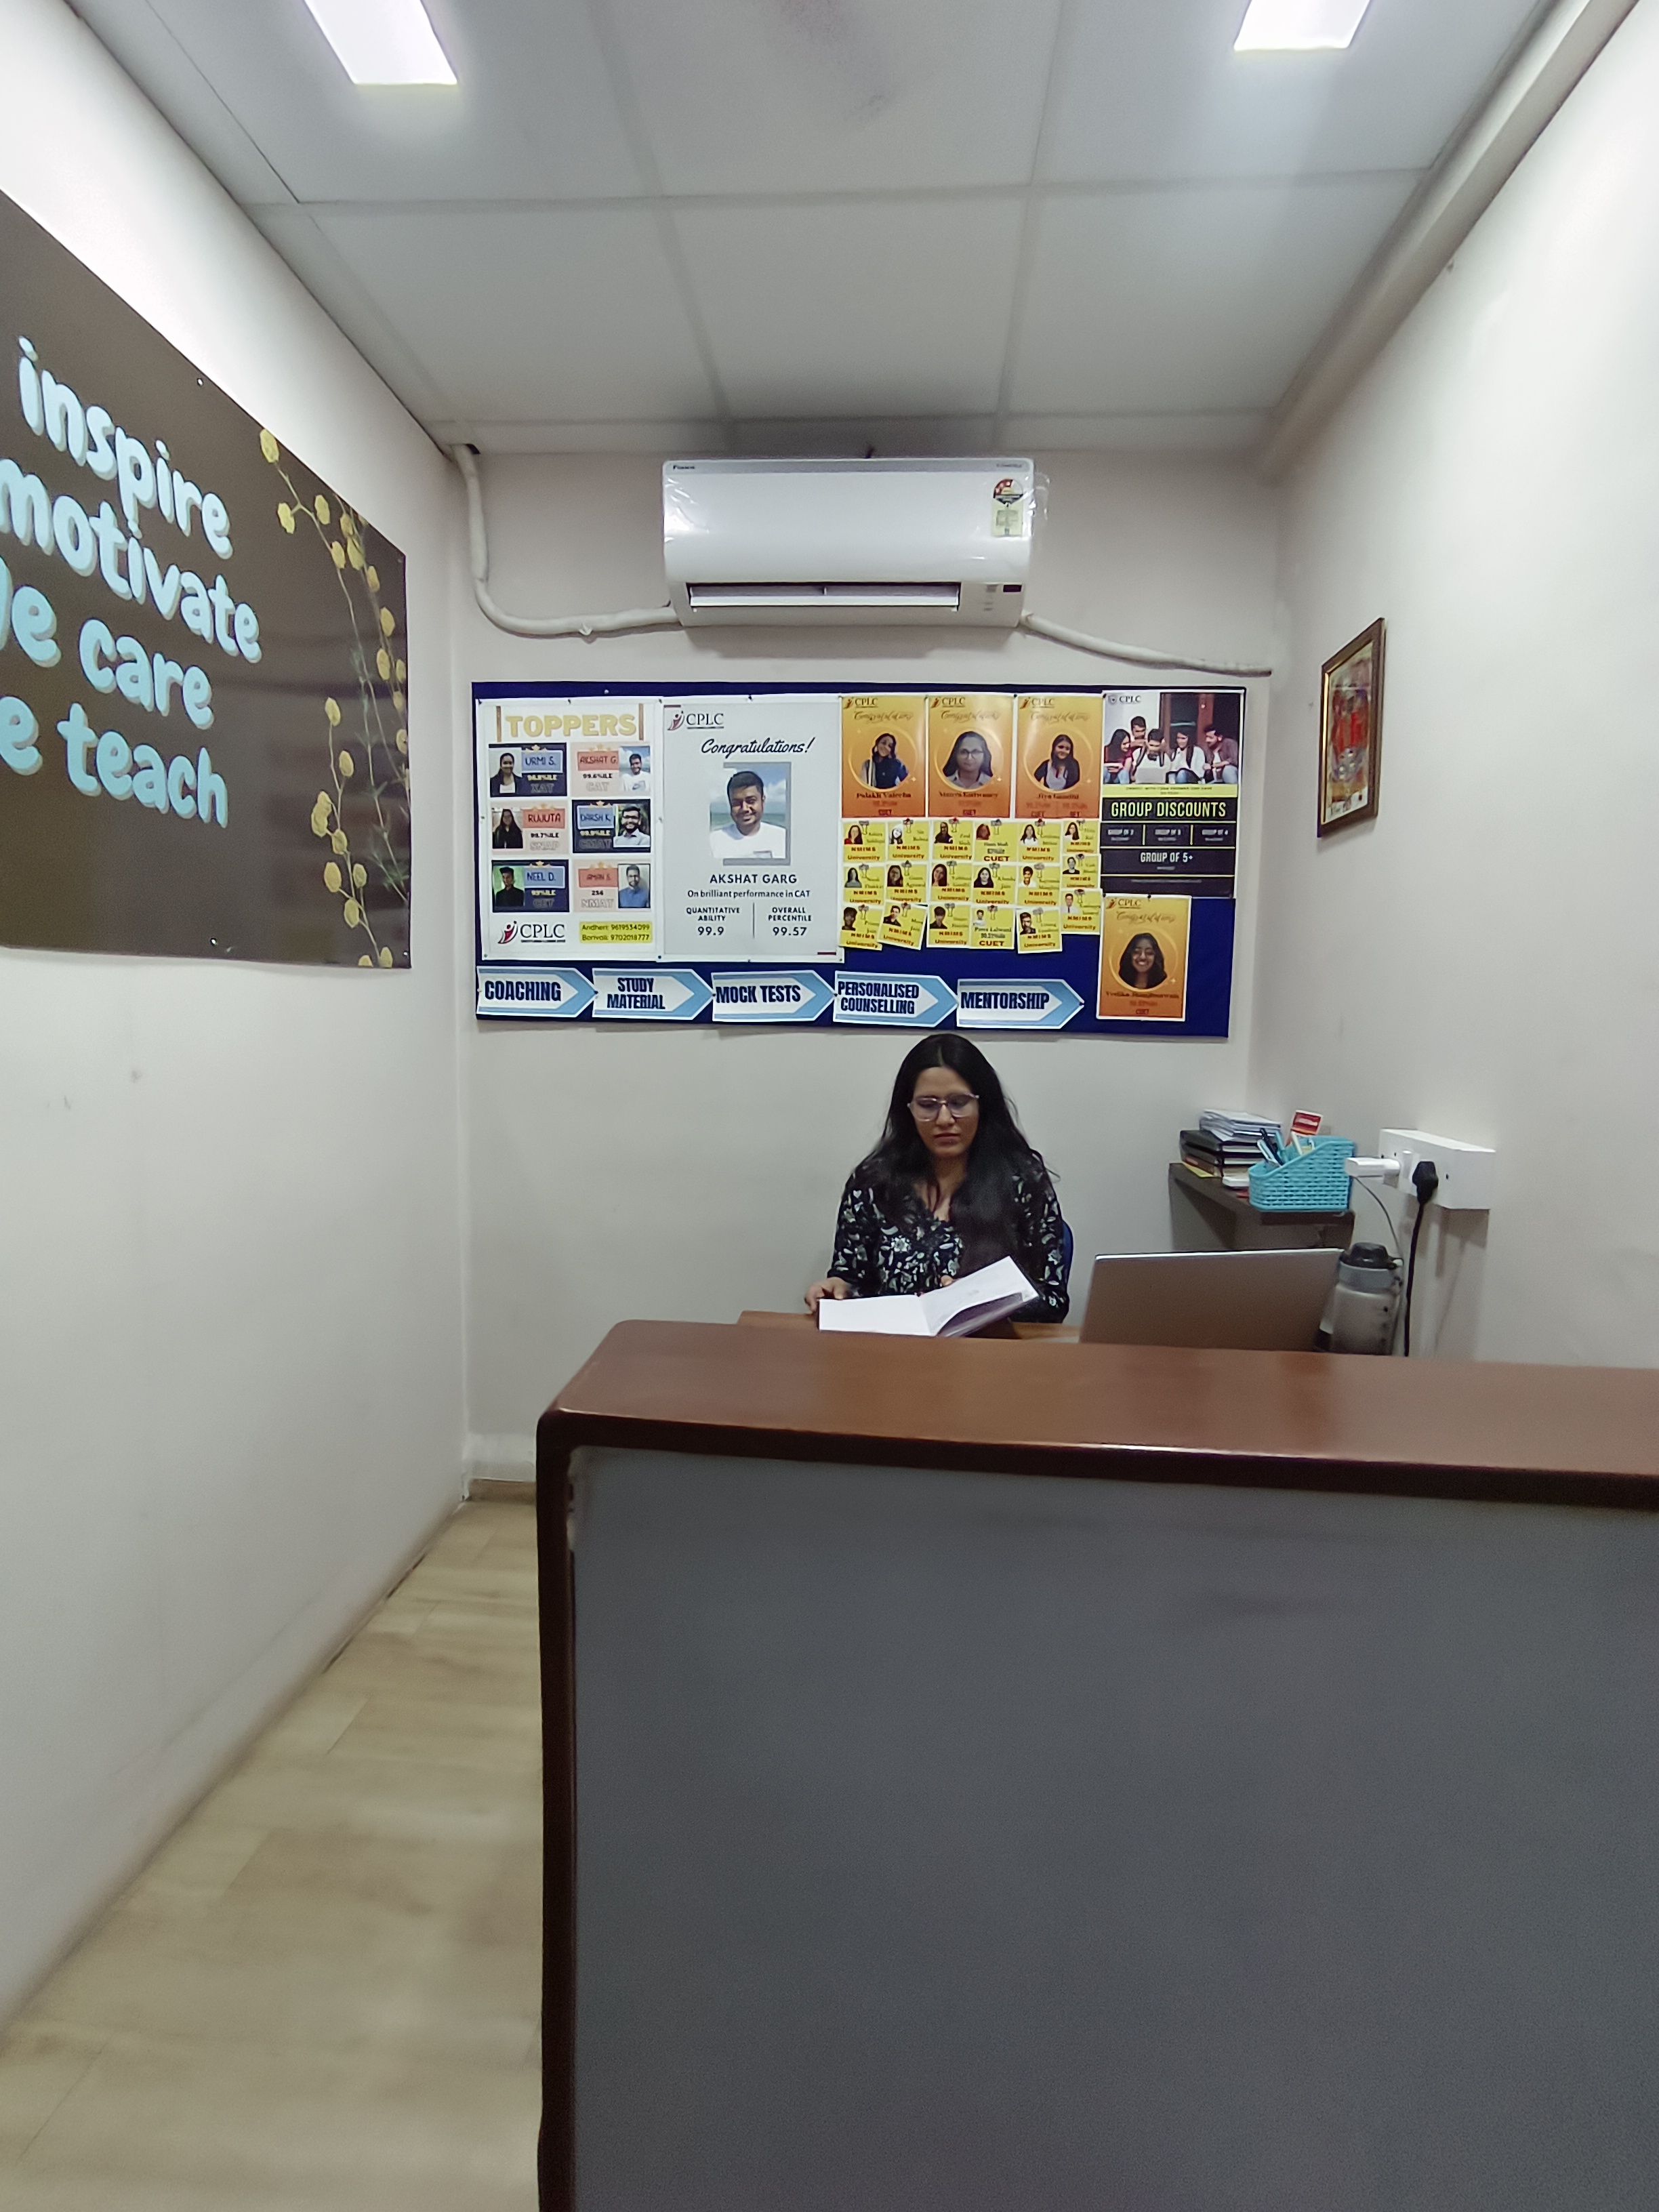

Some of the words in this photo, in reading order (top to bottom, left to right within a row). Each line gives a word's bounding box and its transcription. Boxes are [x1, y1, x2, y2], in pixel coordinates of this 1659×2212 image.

[19, 336, 233, 560] inspire
[0, 457, 262, 663] motivate
[0, 556, 61, 668] e
[79, 618, 215, 729] care
[505, 714, 637, 737] TOPPERS
[687, 714, 724, 725] CPLC
[701, 737, 815, 759] Congratulations!
[57, 702, 228, 828] teach
[525, 756, 545, 766] URMI
[1111, 802, 1152, 817] GROUP
[1156, 802, 1226, 817] DISCOUNTS
[1141, 853, 1168, 863] GROUP
[1170, 853, 1180, 862] OF
[710, 874, 758, 884] AKSHAT
[762, 874, 797, 884] GARG
[733, 890, 784, 899] performance
[520, 924, 565, 938] CPLC
[698, 926, 724, 936] 99.9
[773, 926, 807, 936] 99.57
[485, 980, 561, 1001] COACHING
[617, 977, 654, 992] STUDY
[838, 981, 919, 999] PERSONALISED
[607, 994, 665, 1009] MATERIAL
[716, 986, 757, 1003] MOCK
[760, 985, 801, 1002] TESTS
[961, 992, 1050, 1010] MENTORSHIP
[840, 998, 915, 1014] COUNSELLING
